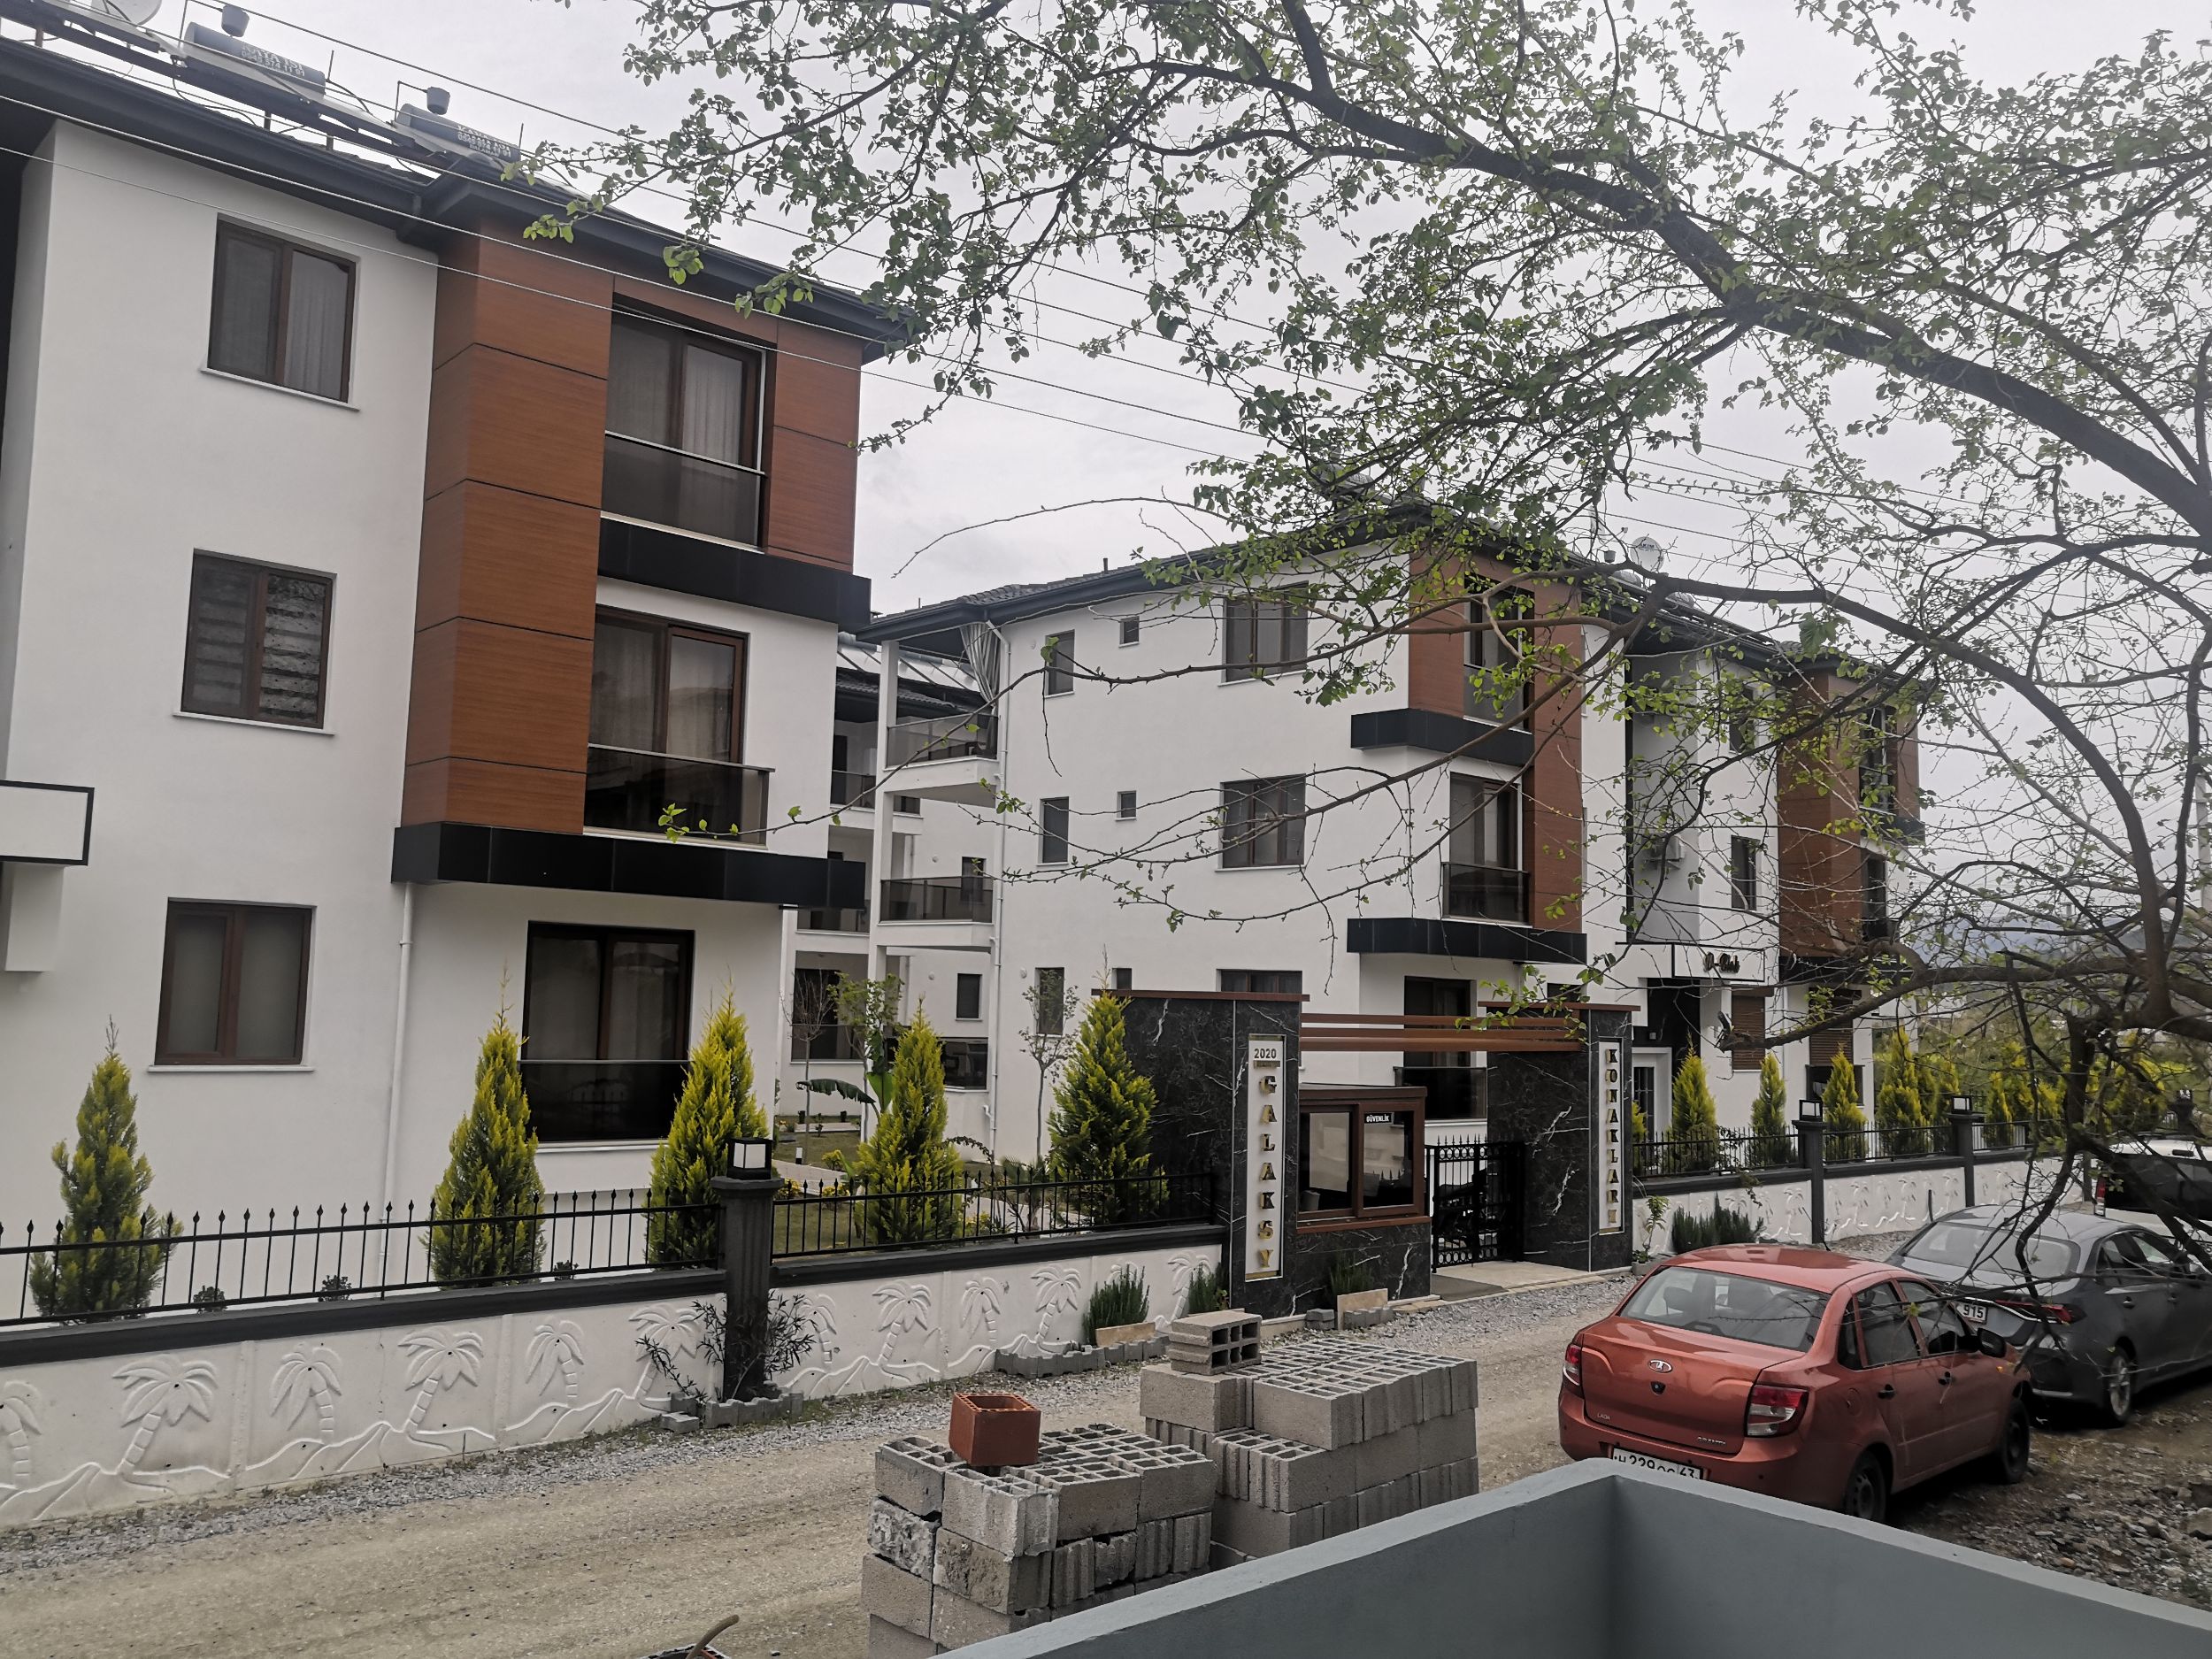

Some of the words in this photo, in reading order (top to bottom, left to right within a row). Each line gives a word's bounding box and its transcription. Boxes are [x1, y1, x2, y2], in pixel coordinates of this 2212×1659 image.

[1254, 1048, 1277, 1059] 2020
[1258, 1075, 1278, 1269] GALAKSY
[1605, 1048, 1619, 1224] KONAKLARI
[1963, 1304, 1984, 1318] 915
